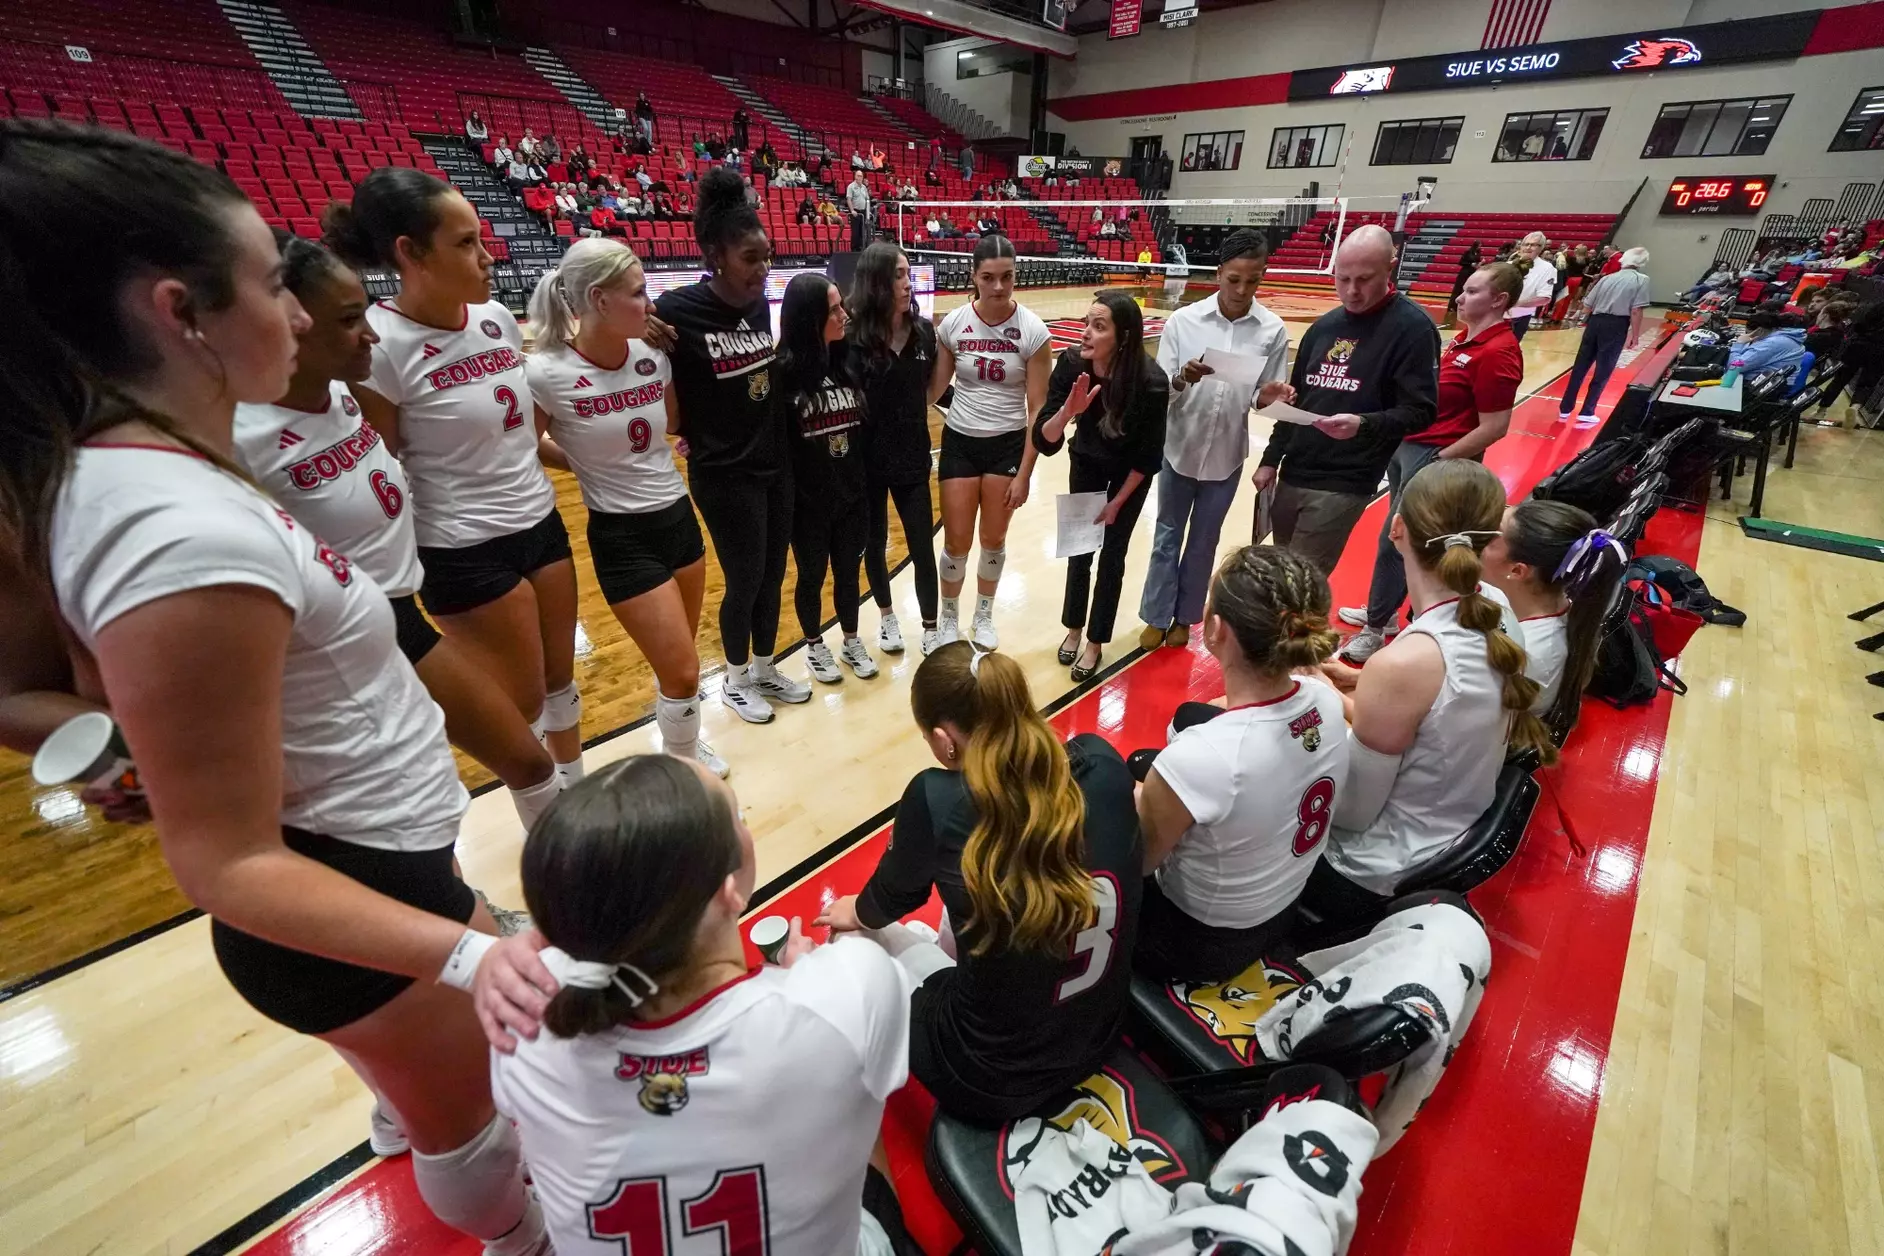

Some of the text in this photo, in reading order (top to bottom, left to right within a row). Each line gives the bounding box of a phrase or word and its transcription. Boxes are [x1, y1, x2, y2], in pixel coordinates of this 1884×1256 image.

[69, 49, 89, 59] 109
[1446, 52, 1560, 78] SIUE VS SEMO
[1677, 192, 1690, 206] 0
[1695, 183, 1732, 197] 28.6
[1750, 192, 1765, 206] 0
[1698, 204, 1719, 213] period
[973, 356, 1006, 382] 16
[1305, 375, 1361, 393] COUGARS
[1319, 363, 1350, 377] SIUE
[493, 384, 525, 432] 2
[627, 417, 652, 453] 9
[283, 417, 381, 491] COUGAR
[368, 469, 404, 520] 6
[1288, 706, 1324, 740] SIUE
[1291, 776, 1336, 857] 8
[1053, 869, 1122, 1005] 3
[614, 1045, 711, 1083] SIUE
[584, 1163, 771, 1256] 11
